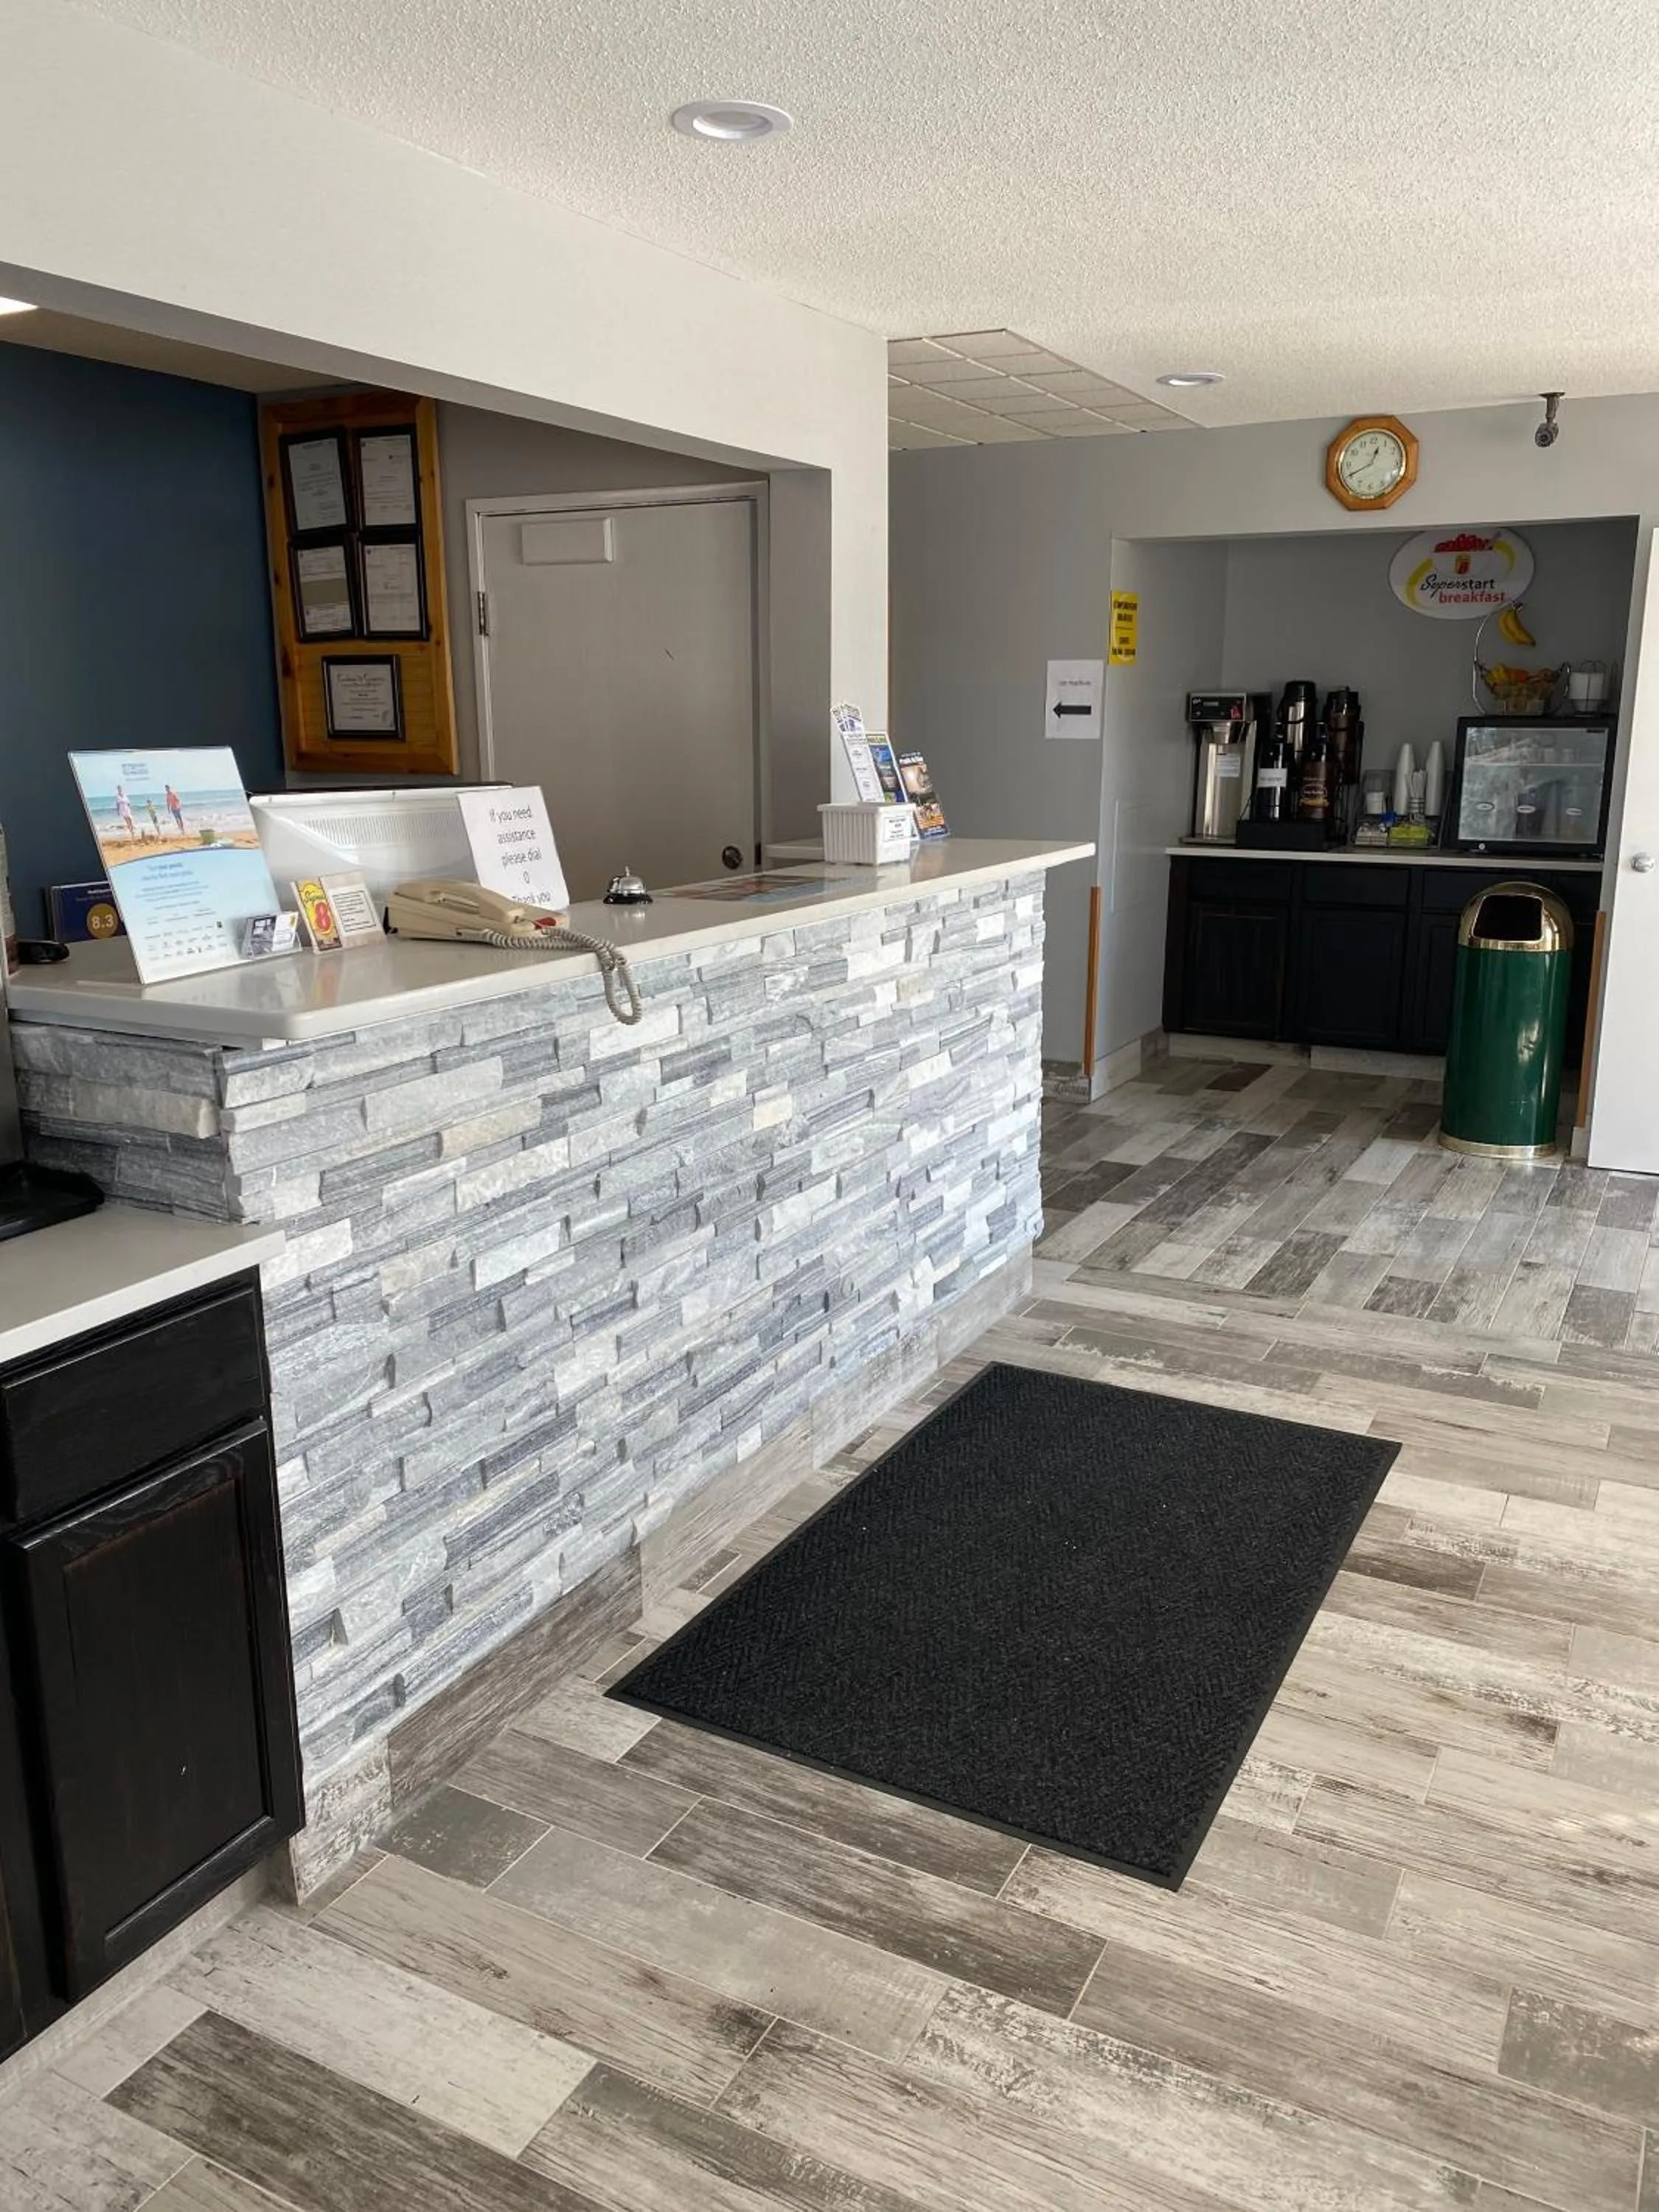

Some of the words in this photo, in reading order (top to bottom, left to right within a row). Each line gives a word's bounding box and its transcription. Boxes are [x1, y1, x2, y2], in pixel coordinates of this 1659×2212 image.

[1420, 573, 1496, 598] Superstart
[1439, 591, 1506, 603] breakfast
[496, 811, 512, 824] you
[512, 805, 532, 820] need
[497, 829, 535, 844] assistance
[501, 852, 526, 870] please
[536, 891, 552, 905] you
